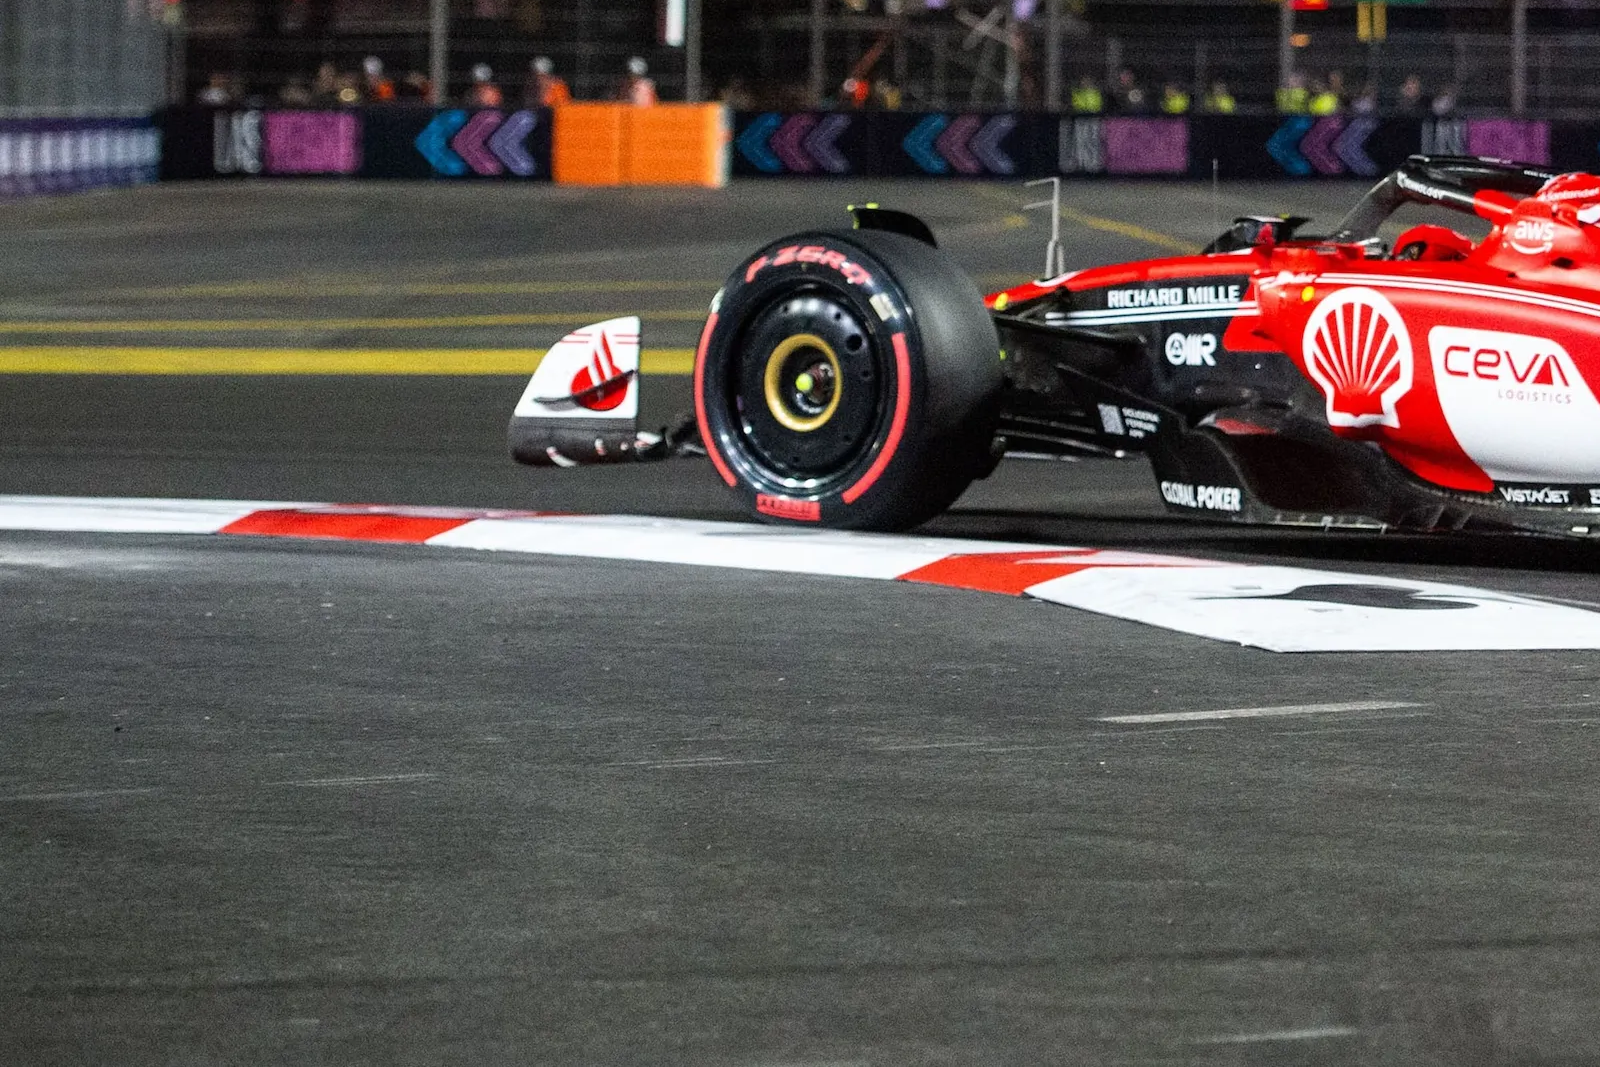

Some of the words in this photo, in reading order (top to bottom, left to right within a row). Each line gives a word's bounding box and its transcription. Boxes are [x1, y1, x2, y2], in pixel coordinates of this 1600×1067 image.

[1514, 221, 1555, 241] aws
[1107, 287, 1184, 309] RICHARD
[1187, 285, 1241, 304] MILLE
[1498, 389, 1572, 405] LOGISTICS
[1197, 485, 1241, 511] POKER
